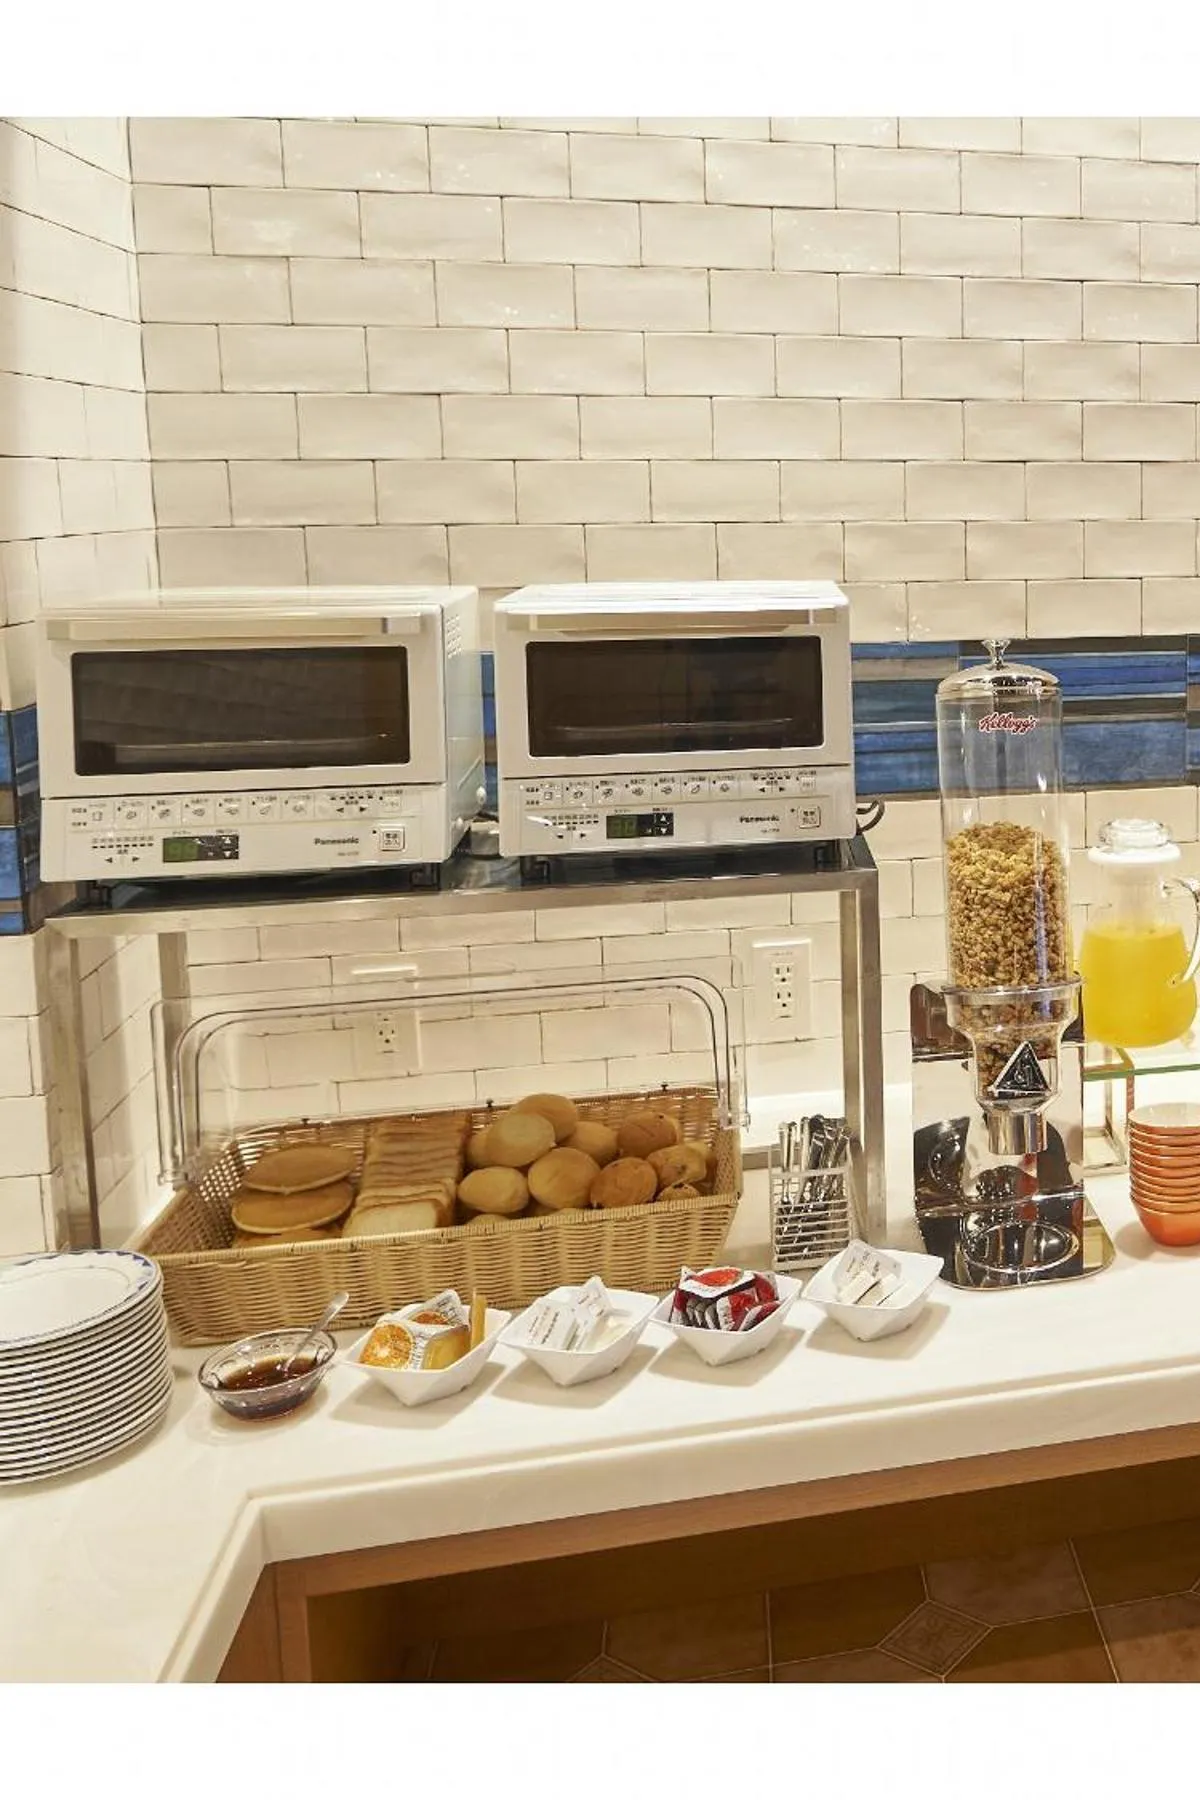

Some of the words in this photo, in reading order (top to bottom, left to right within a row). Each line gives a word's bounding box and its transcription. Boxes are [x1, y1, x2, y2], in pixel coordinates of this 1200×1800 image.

[979, 712, 1036, 734] Kellogg's
[739, 814, 780, 824] Panasonic
[314, 836, 360, 846] Panasonic
